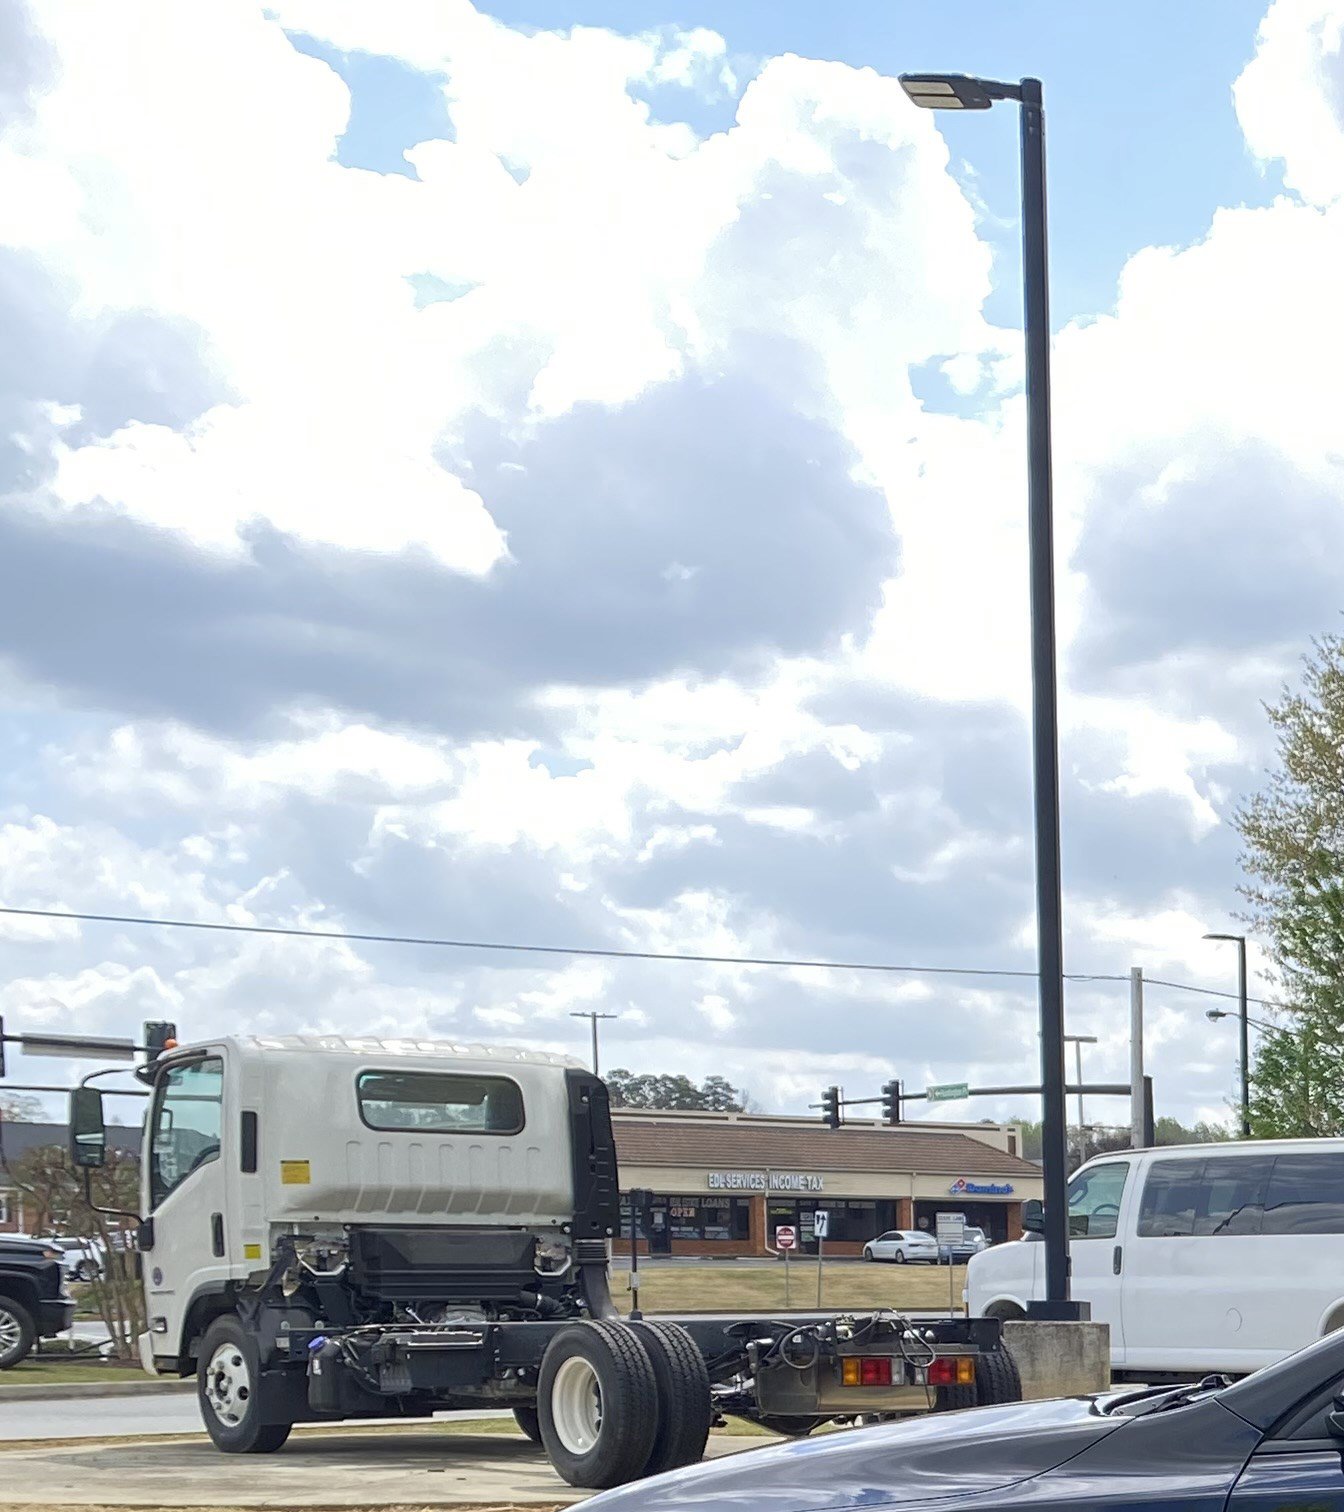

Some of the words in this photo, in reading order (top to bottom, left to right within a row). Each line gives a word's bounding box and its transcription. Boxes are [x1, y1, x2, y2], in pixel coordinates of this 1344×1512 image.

[726, 1173, 765, 1189] SERVICES
[769, 1174, 806, 1190] INCOME
[807, 1175, 824, 1190] TAX
[701, 1198, 730, 1208] LOANS
[670, 1207, 695, 1217] OPEN
